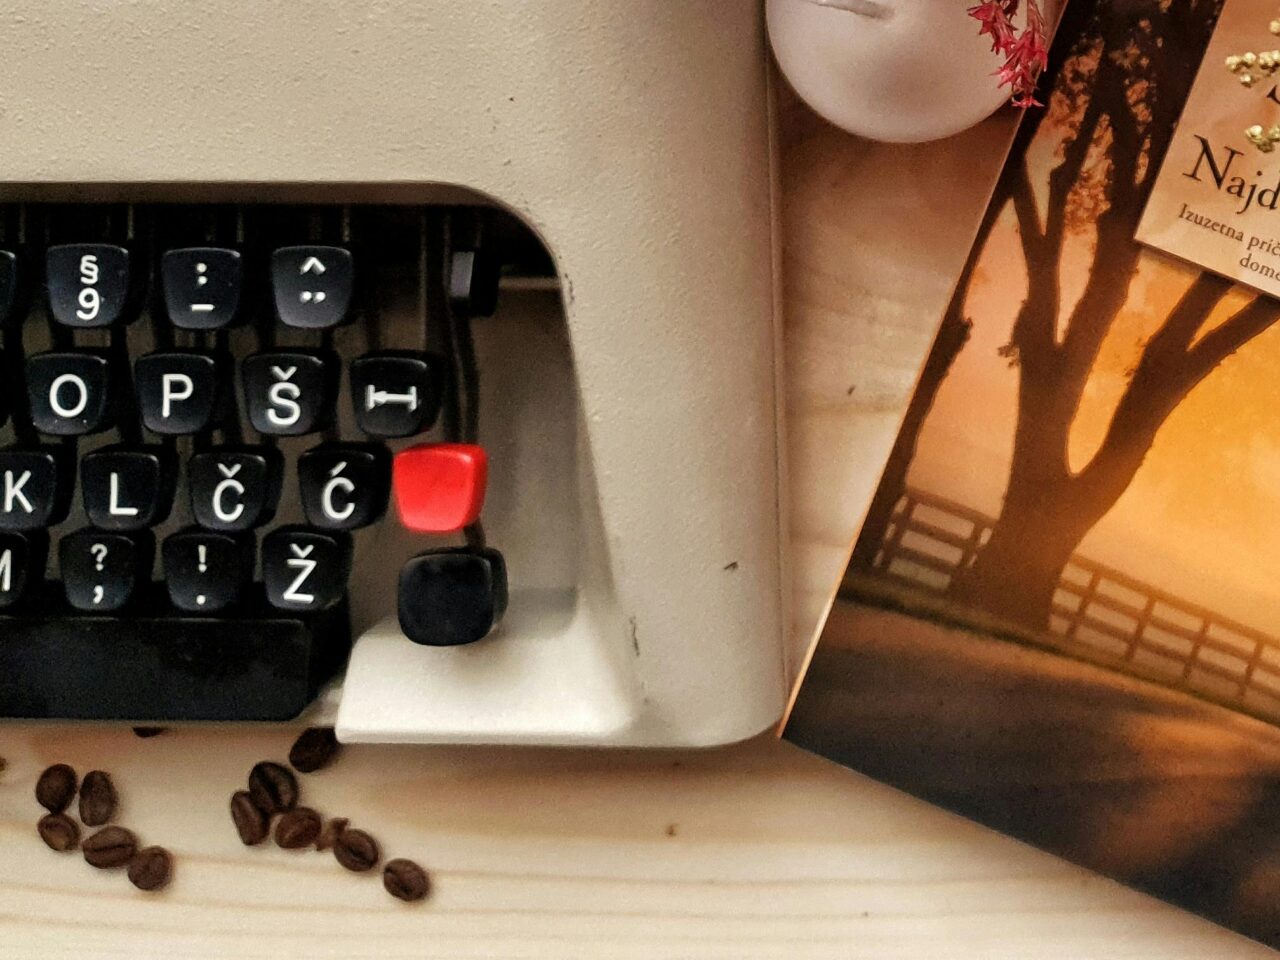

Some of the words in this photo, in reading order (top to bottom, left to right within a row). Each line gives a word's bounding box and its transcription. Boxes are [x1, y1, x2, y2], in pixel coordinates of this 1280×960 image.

[1178, 203, 1244, 242] Izuzetna
[76, 288, 101, 321] 9
[49, 374, 88, 419] O
[161, 373, 194, 419] P
[267, 365, 301, 427] Š
[3, 471, 37, 514] K
[109, 472, 139, 515] L
[212, 463, 246, 522] Č
[321, 461, 355, 521] Ć
[283, 543, 319, 603] Ž
